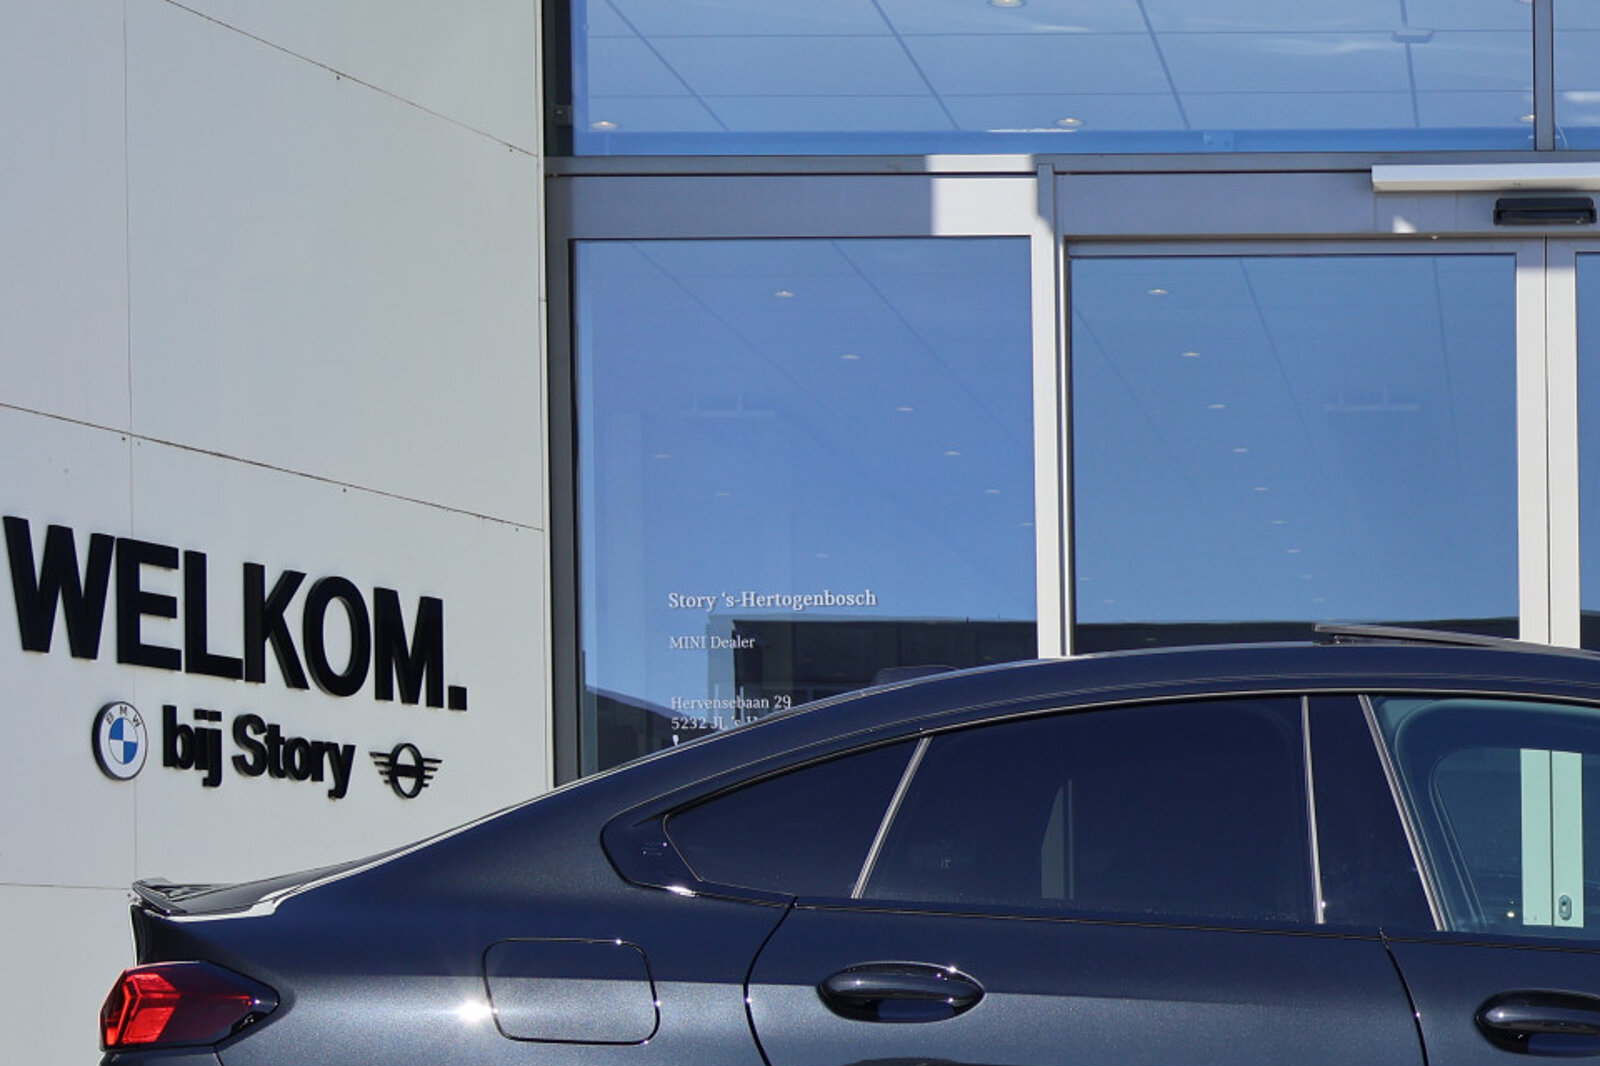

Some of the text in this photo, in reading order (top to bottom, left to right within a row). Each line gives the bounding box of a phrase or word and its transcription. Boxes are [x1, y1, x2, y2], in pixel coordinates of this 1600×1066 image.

[668, 589, 878, 613] Story 's-Hertogenbosch
[2, 515, 468, 712] WELKOM.
[669, 635, 756, 650] MINI Dealer
[671, 694, 791, 711] Hervensebaan 29
[671, 715, 708, 731] 5232
[162, 704, 357, 800] bij Story
